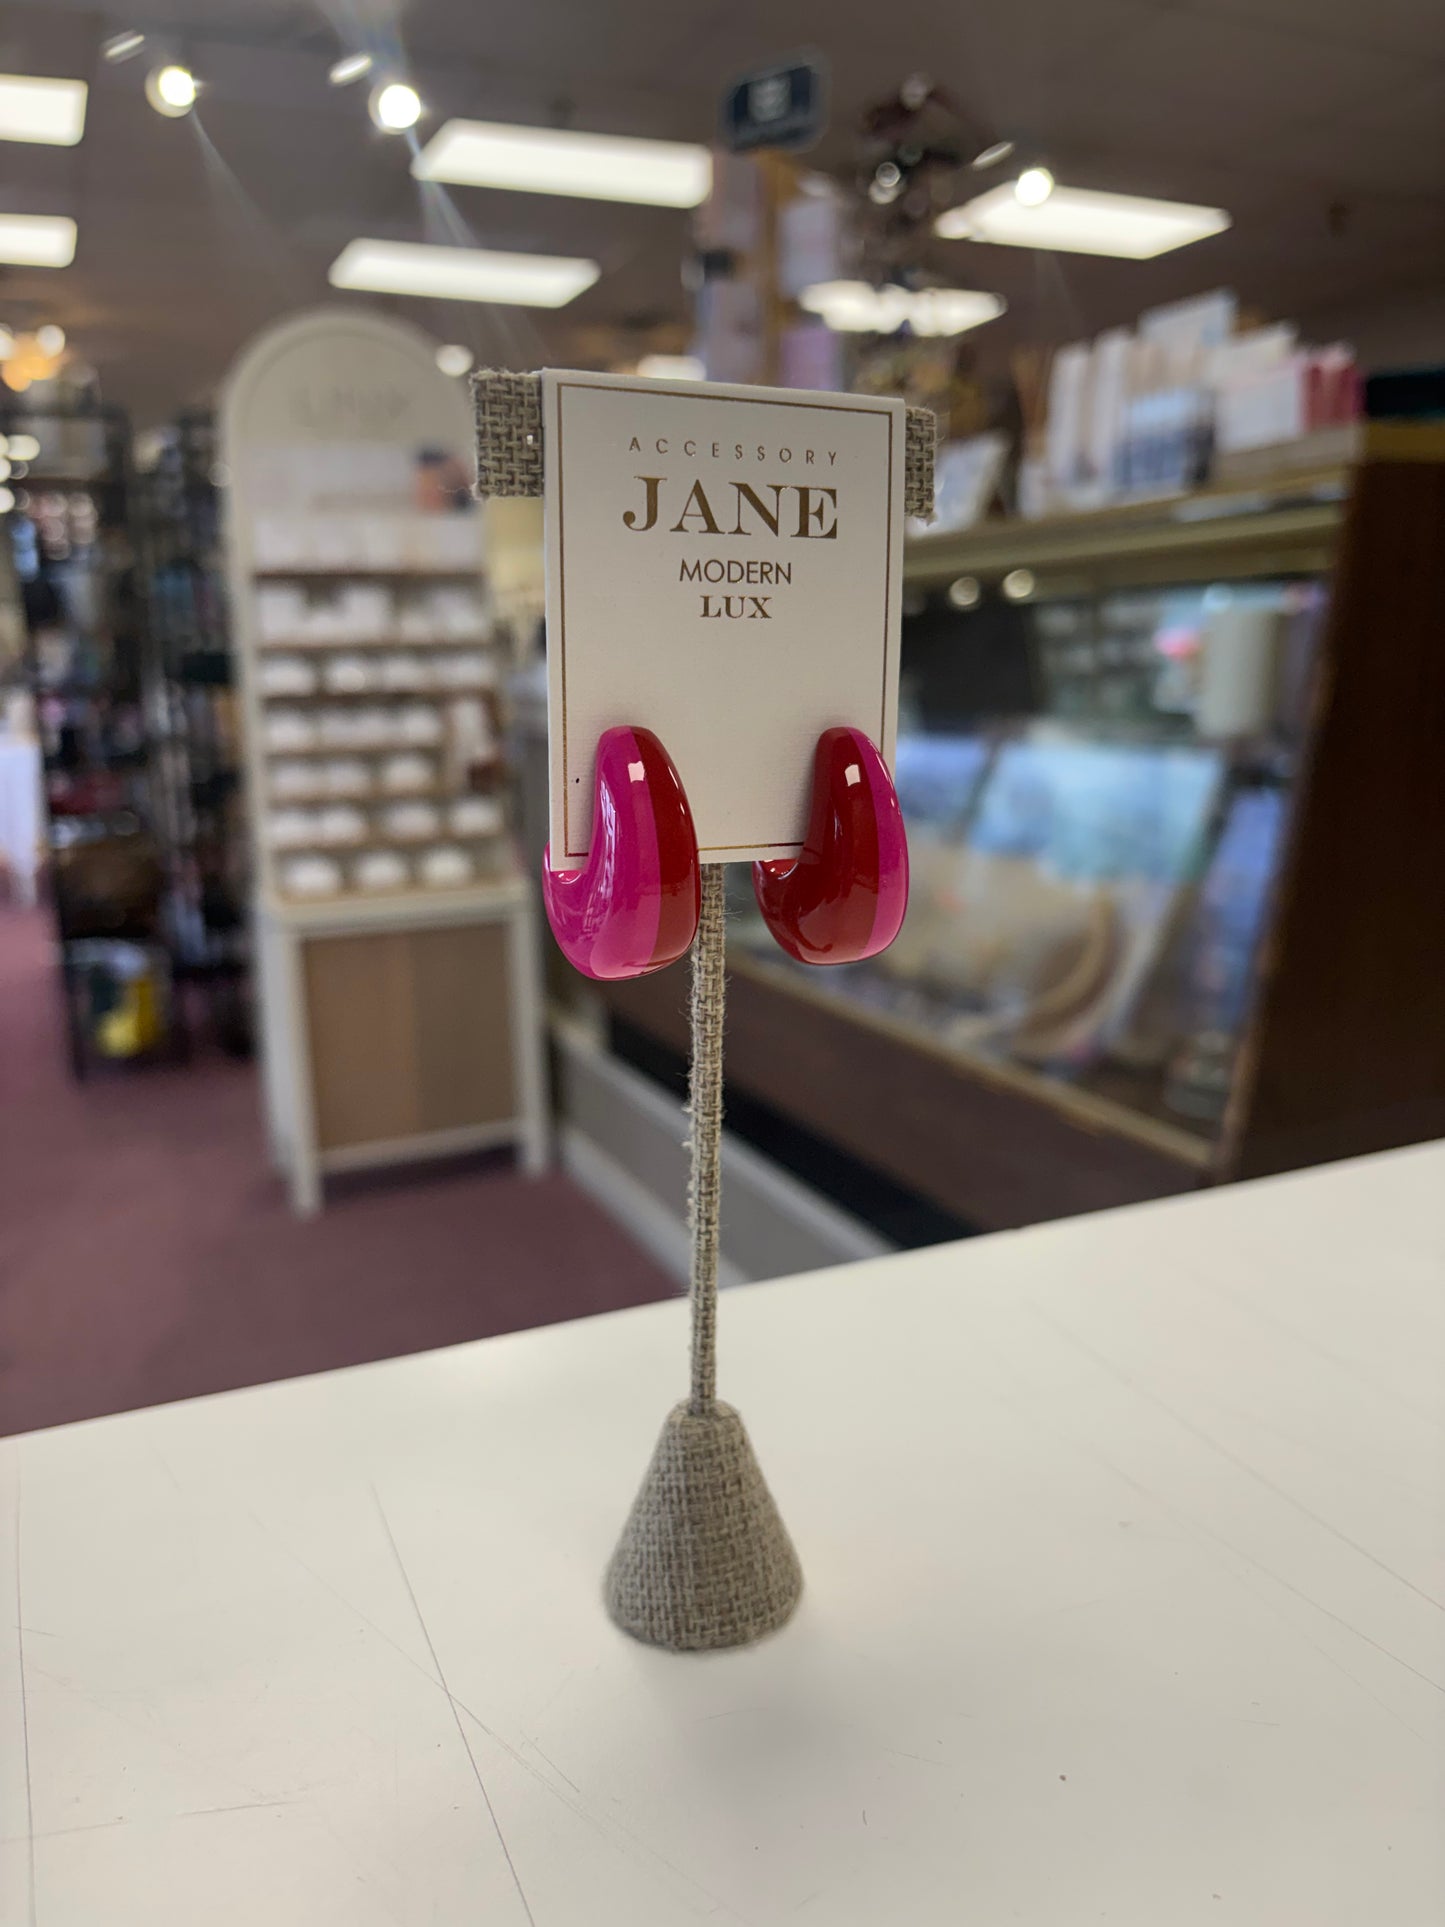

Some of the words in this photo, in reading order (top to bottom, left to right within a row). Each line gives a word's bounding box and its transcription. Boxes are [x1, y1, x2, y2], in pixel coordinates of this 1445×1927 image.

[629, 437, 837, 465] ACCESSORY
[622, 476, 838, 539] JANE
[679, 559, 792, 584] MODERN
[700, 595, 773, 619] LUX
